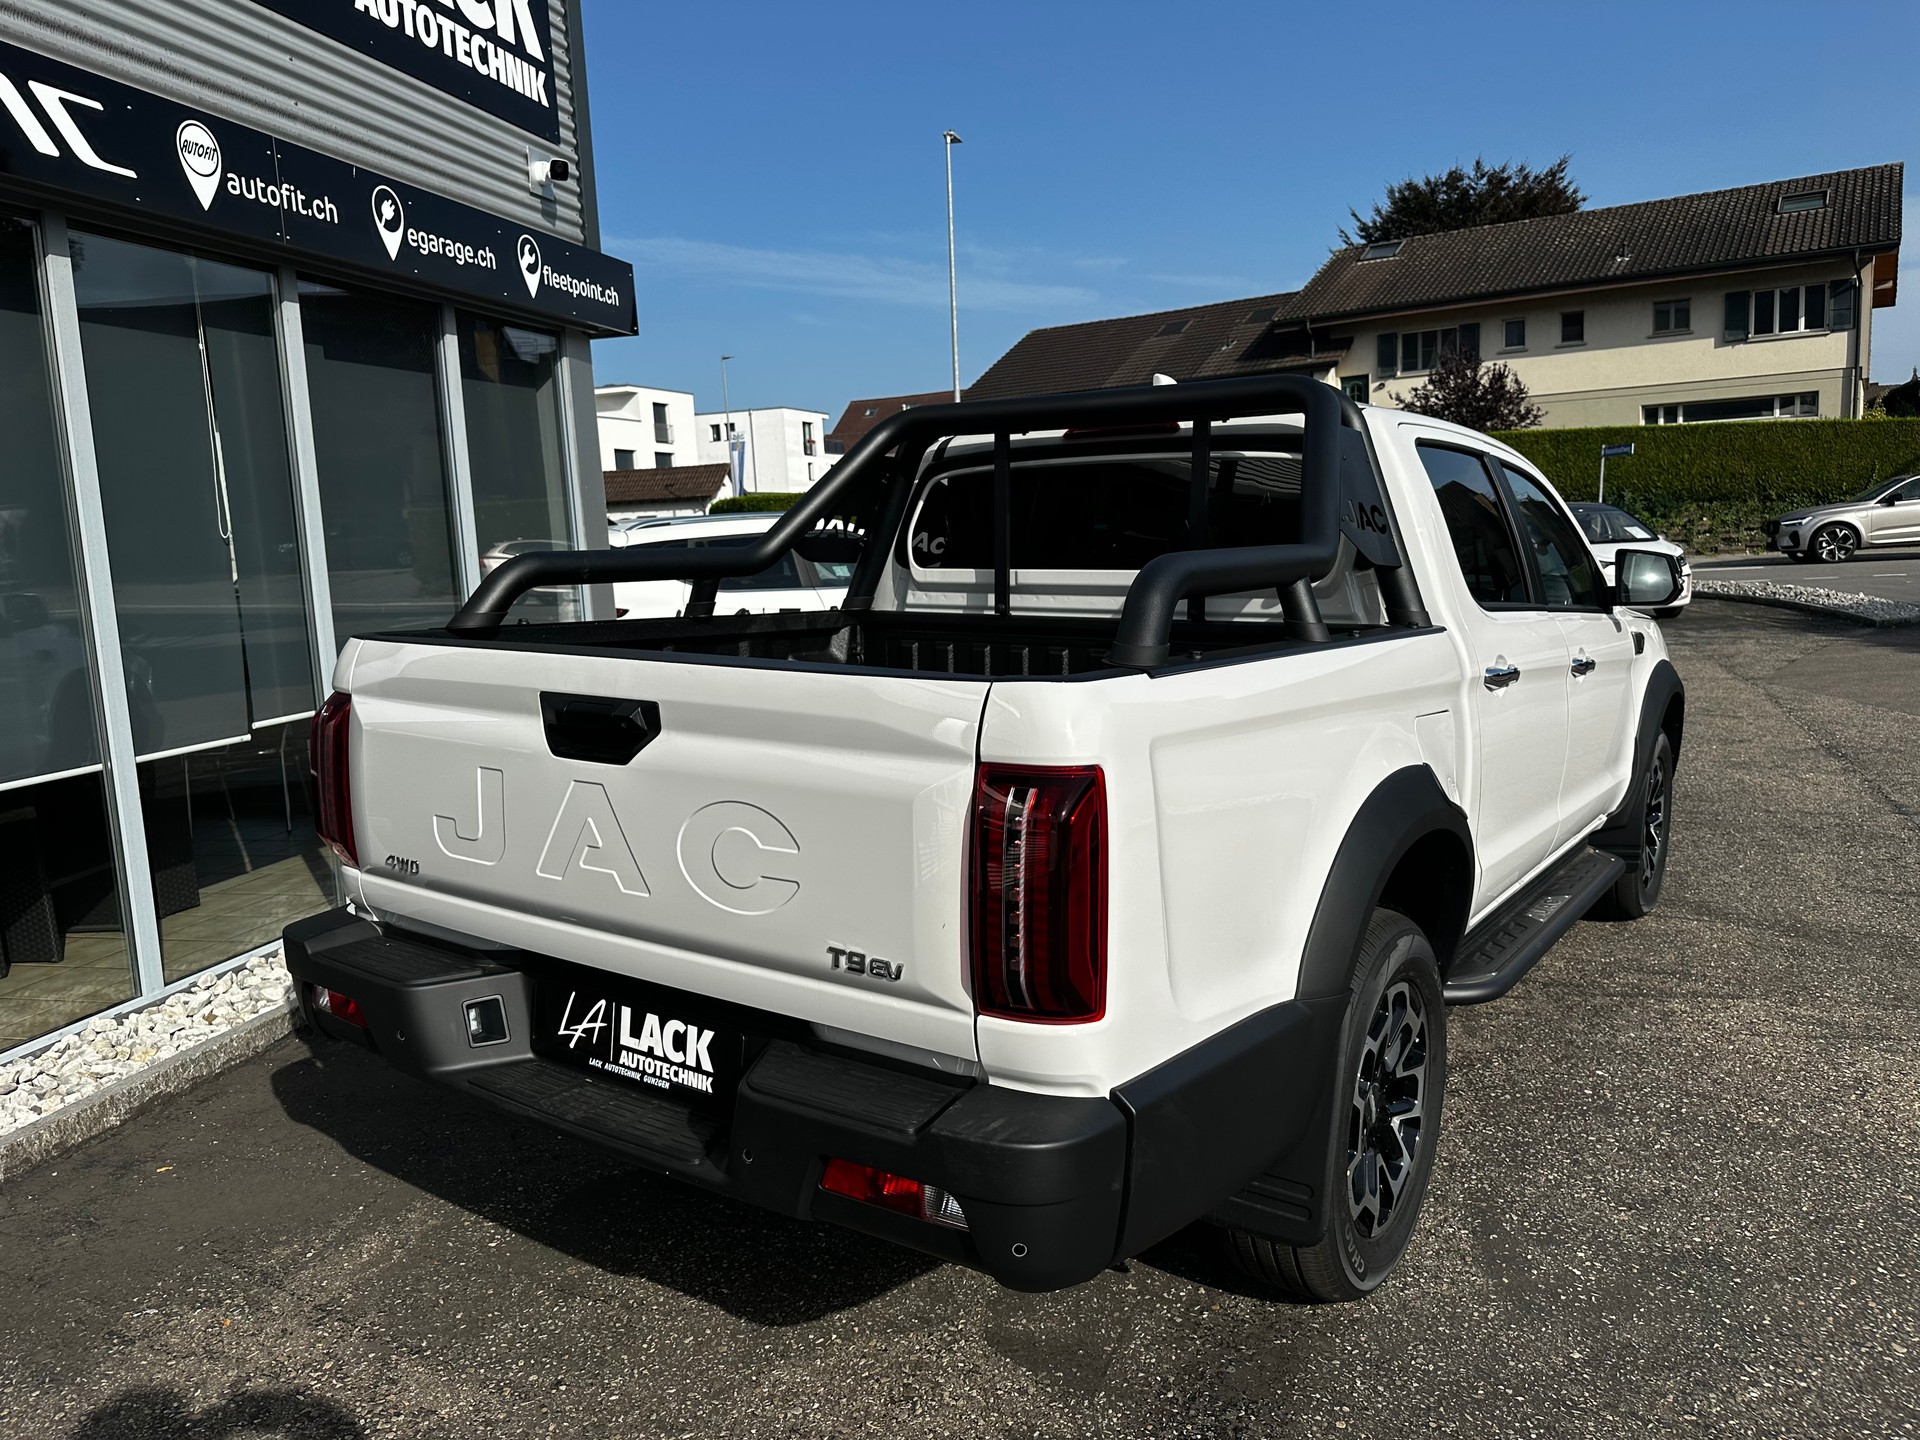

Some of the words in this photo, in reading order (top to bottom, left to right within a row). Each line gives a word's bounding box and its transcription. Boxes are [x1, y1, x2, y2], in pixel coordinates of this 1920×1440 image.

[226, 172, 339, 224] autofit.ch
[407, 228, 497, 270] egarage.ch
[542, 265, 619, 306] fleetpoint.ch
[432, 765, 801, 916] JAC
[385, 854, 420, 876] 4WD
[619, 1005, 715, 1073] LACK
[589, 1057, 603, 1069] LACK
[604, 1062, 642, 1081] AUTOTECHNIK
[618, 1050, 714, 1094] AUTOTECHNIK
